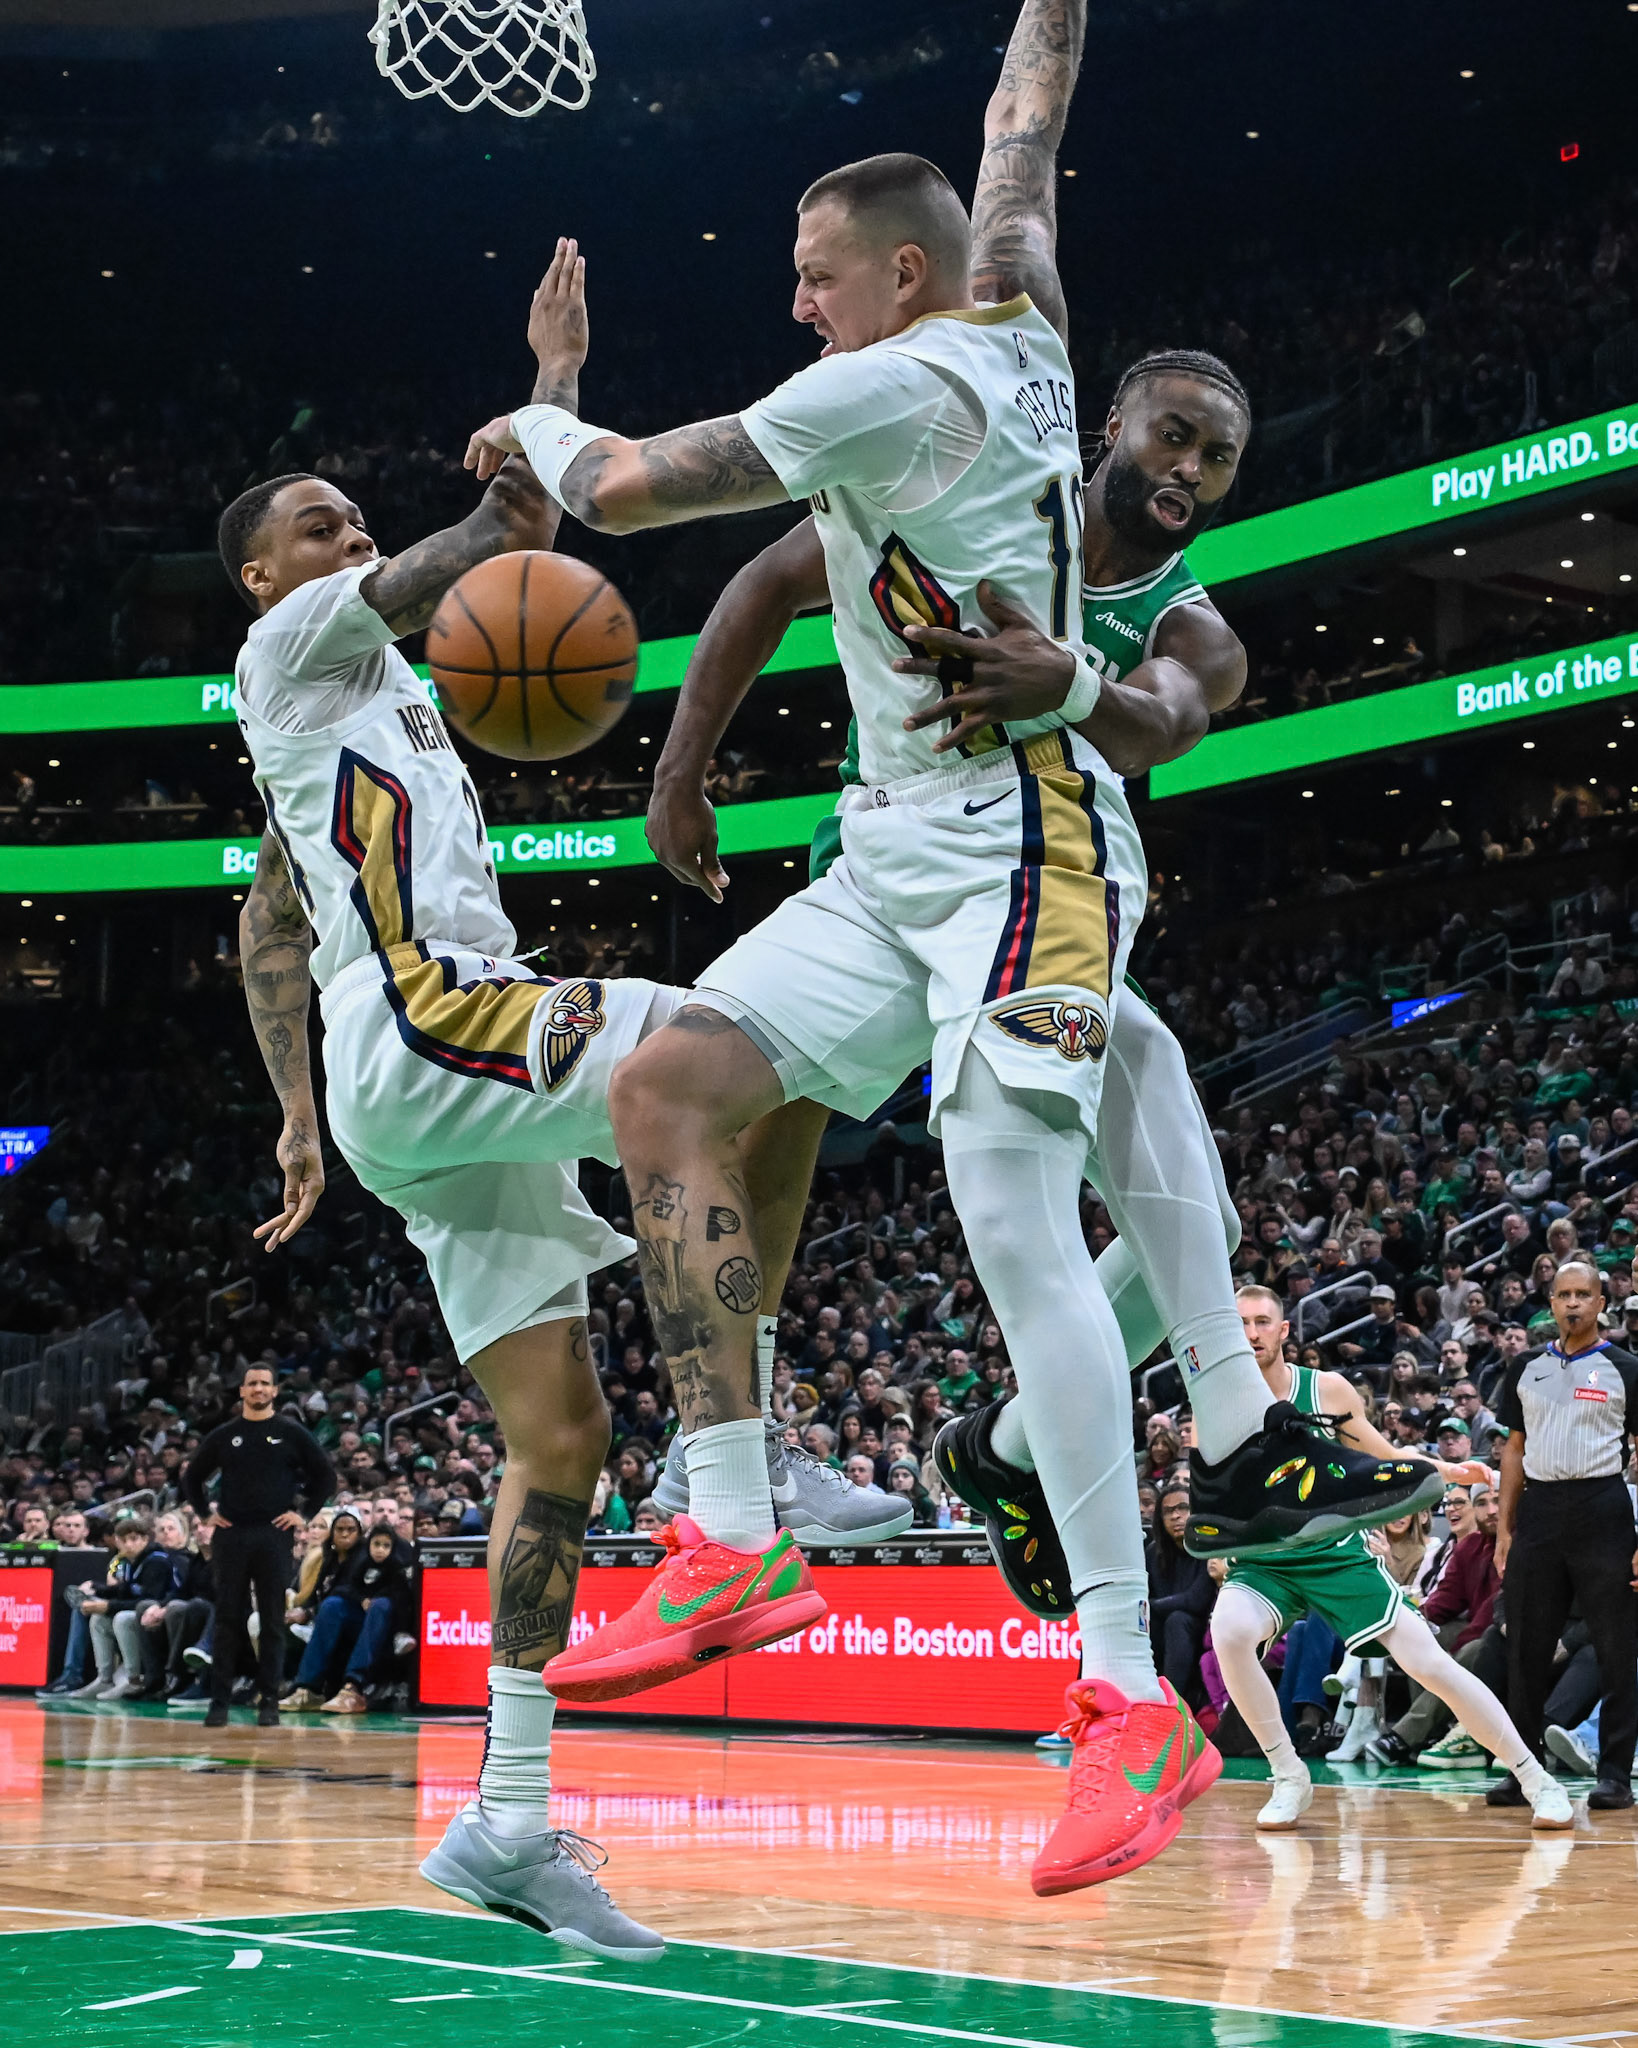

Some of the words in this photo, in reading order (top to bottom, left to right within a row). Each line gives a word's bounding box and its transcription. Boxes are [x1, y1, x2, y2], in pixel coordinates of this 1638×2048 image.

[1015, 379, 1073, 443] THEIS
[1432, 464, 1496, 507] Play
[1502, 432, 1600, 486] HARD.
[1457, 670, 1530, 717] Bank
[1535, 659, 1567, 698] of
[1572, 653, 1622, 690] the
[511, 831, 617, 863] Celtics
[652, 1198, 676, 1221] 27
[809, 1613, 839, 1654] of
[842, 1614, 888, 1656] the
[894, 1616, 994, 1658] Boston
